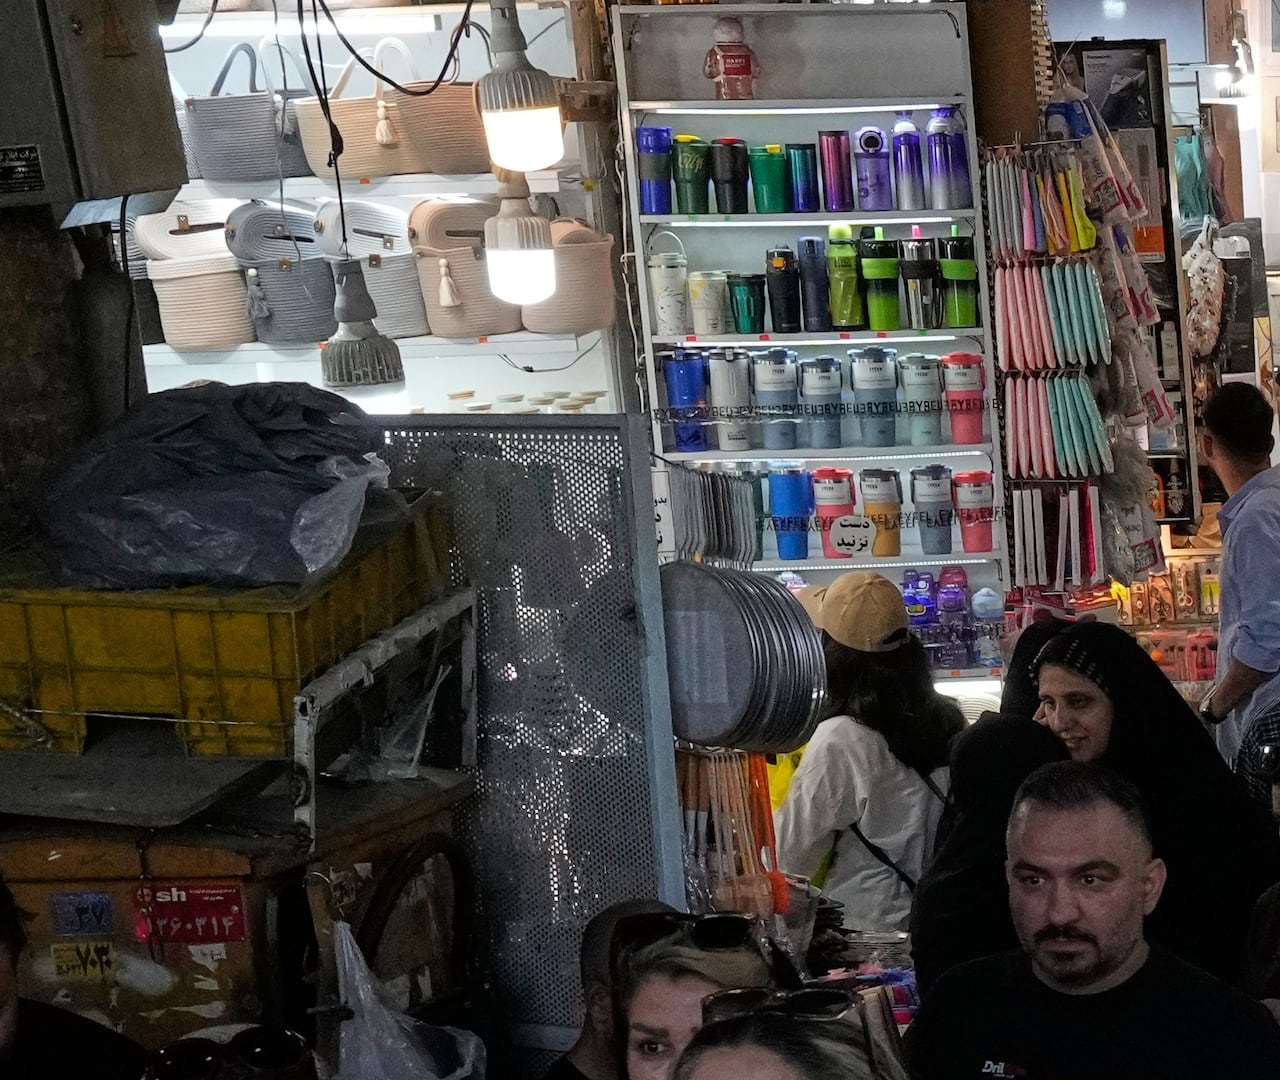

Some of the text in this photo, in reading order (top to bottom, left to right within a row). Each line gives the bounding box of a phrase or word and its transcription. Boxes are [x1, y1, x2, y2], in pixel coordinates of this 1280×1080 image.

[839, 518, 870, 530] دست
[837, 534, 869, 552] نزنید
[156, 887, 187, 902] sh
